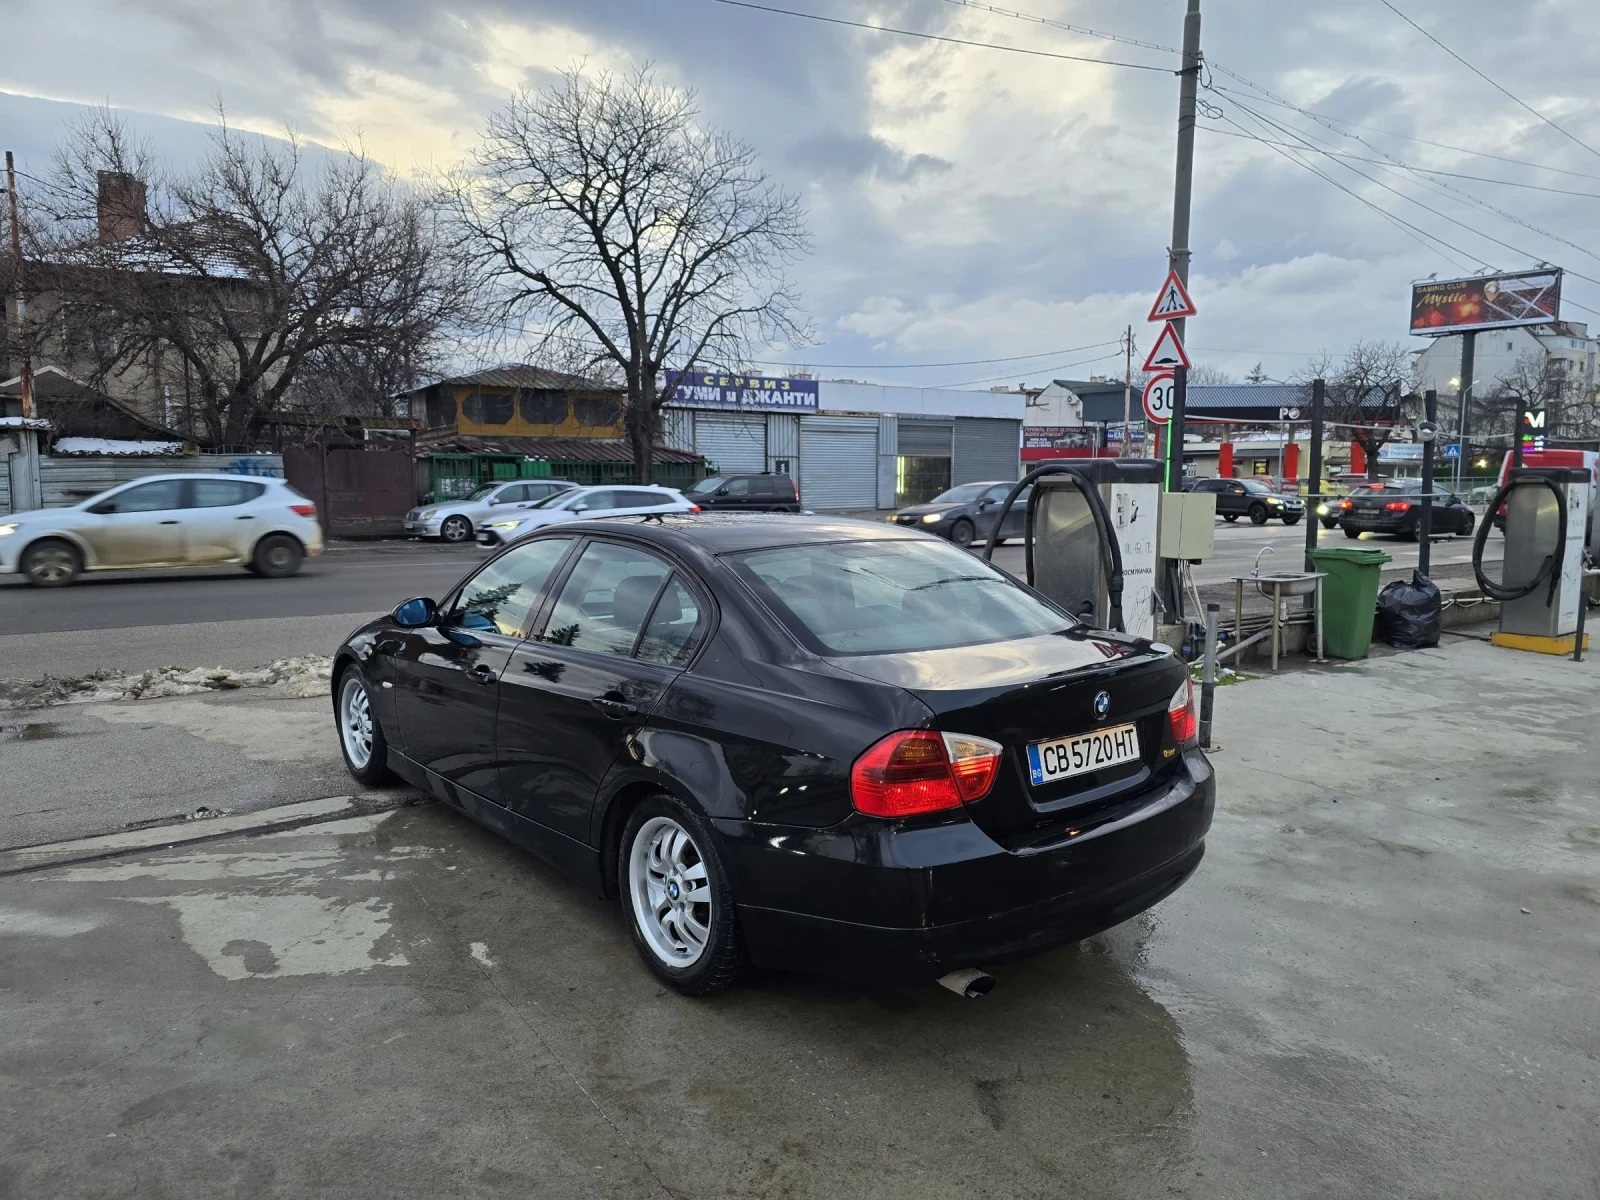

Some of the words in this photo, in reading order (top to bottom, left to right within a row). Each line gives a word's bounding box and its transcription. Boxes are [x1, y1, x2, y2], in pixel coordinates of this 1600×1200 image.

[1416, 285, 1446, 293] GAMING
[1447, 282, 1467, 291] CLUB
[1416, 293, 1467, 308] Mystic
[703, 376, 790, 390] СЕРВИЗ
[743, 389, 816, 406] ДЖАНТИ
[1044, 744, 1070, 775] CB
[1071, 734, 1113, 768] 5720
[1115, 728, 1135, 759] HT
[1032, 770, 1042, 779] BG
